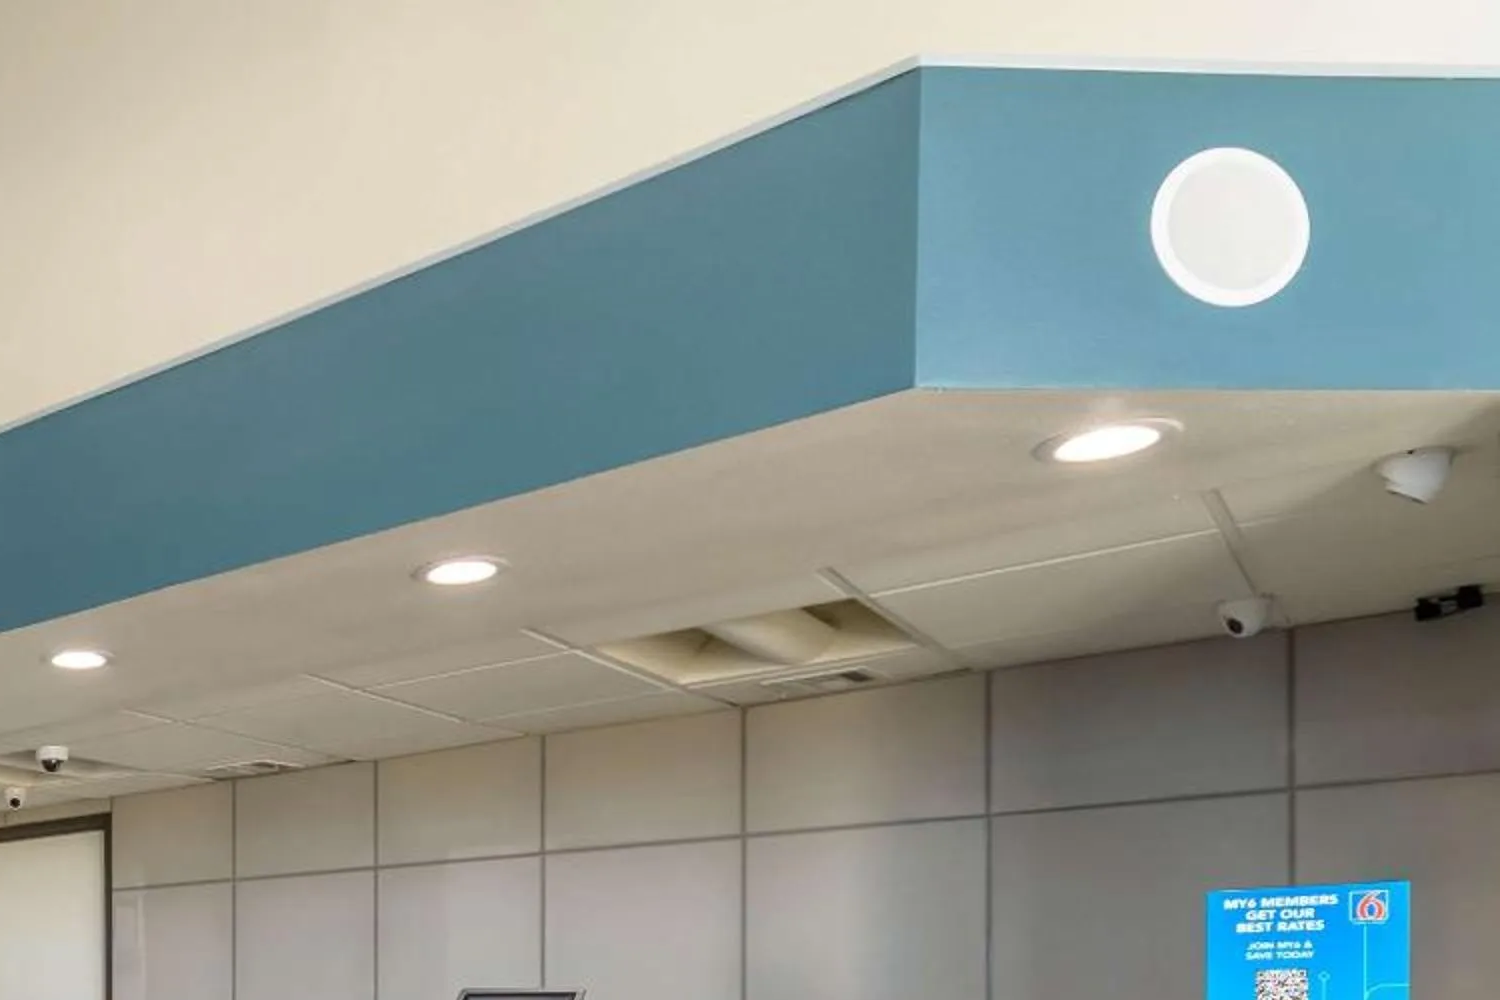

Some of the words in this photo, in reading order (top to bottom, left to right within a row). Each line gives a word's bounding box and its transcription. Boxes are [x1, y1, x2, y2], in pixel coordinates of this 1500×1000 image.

[1261, 894, 1339, 908] MEMBERS
[1245, 909, 1276, 921] GET
[1280, 908, 1316, 920] OUR
[1235, 922, 1273, 933] BEST
[1276, 920, 1325, 932] RATES
[1276, 950, 1315, 960] TODAY
